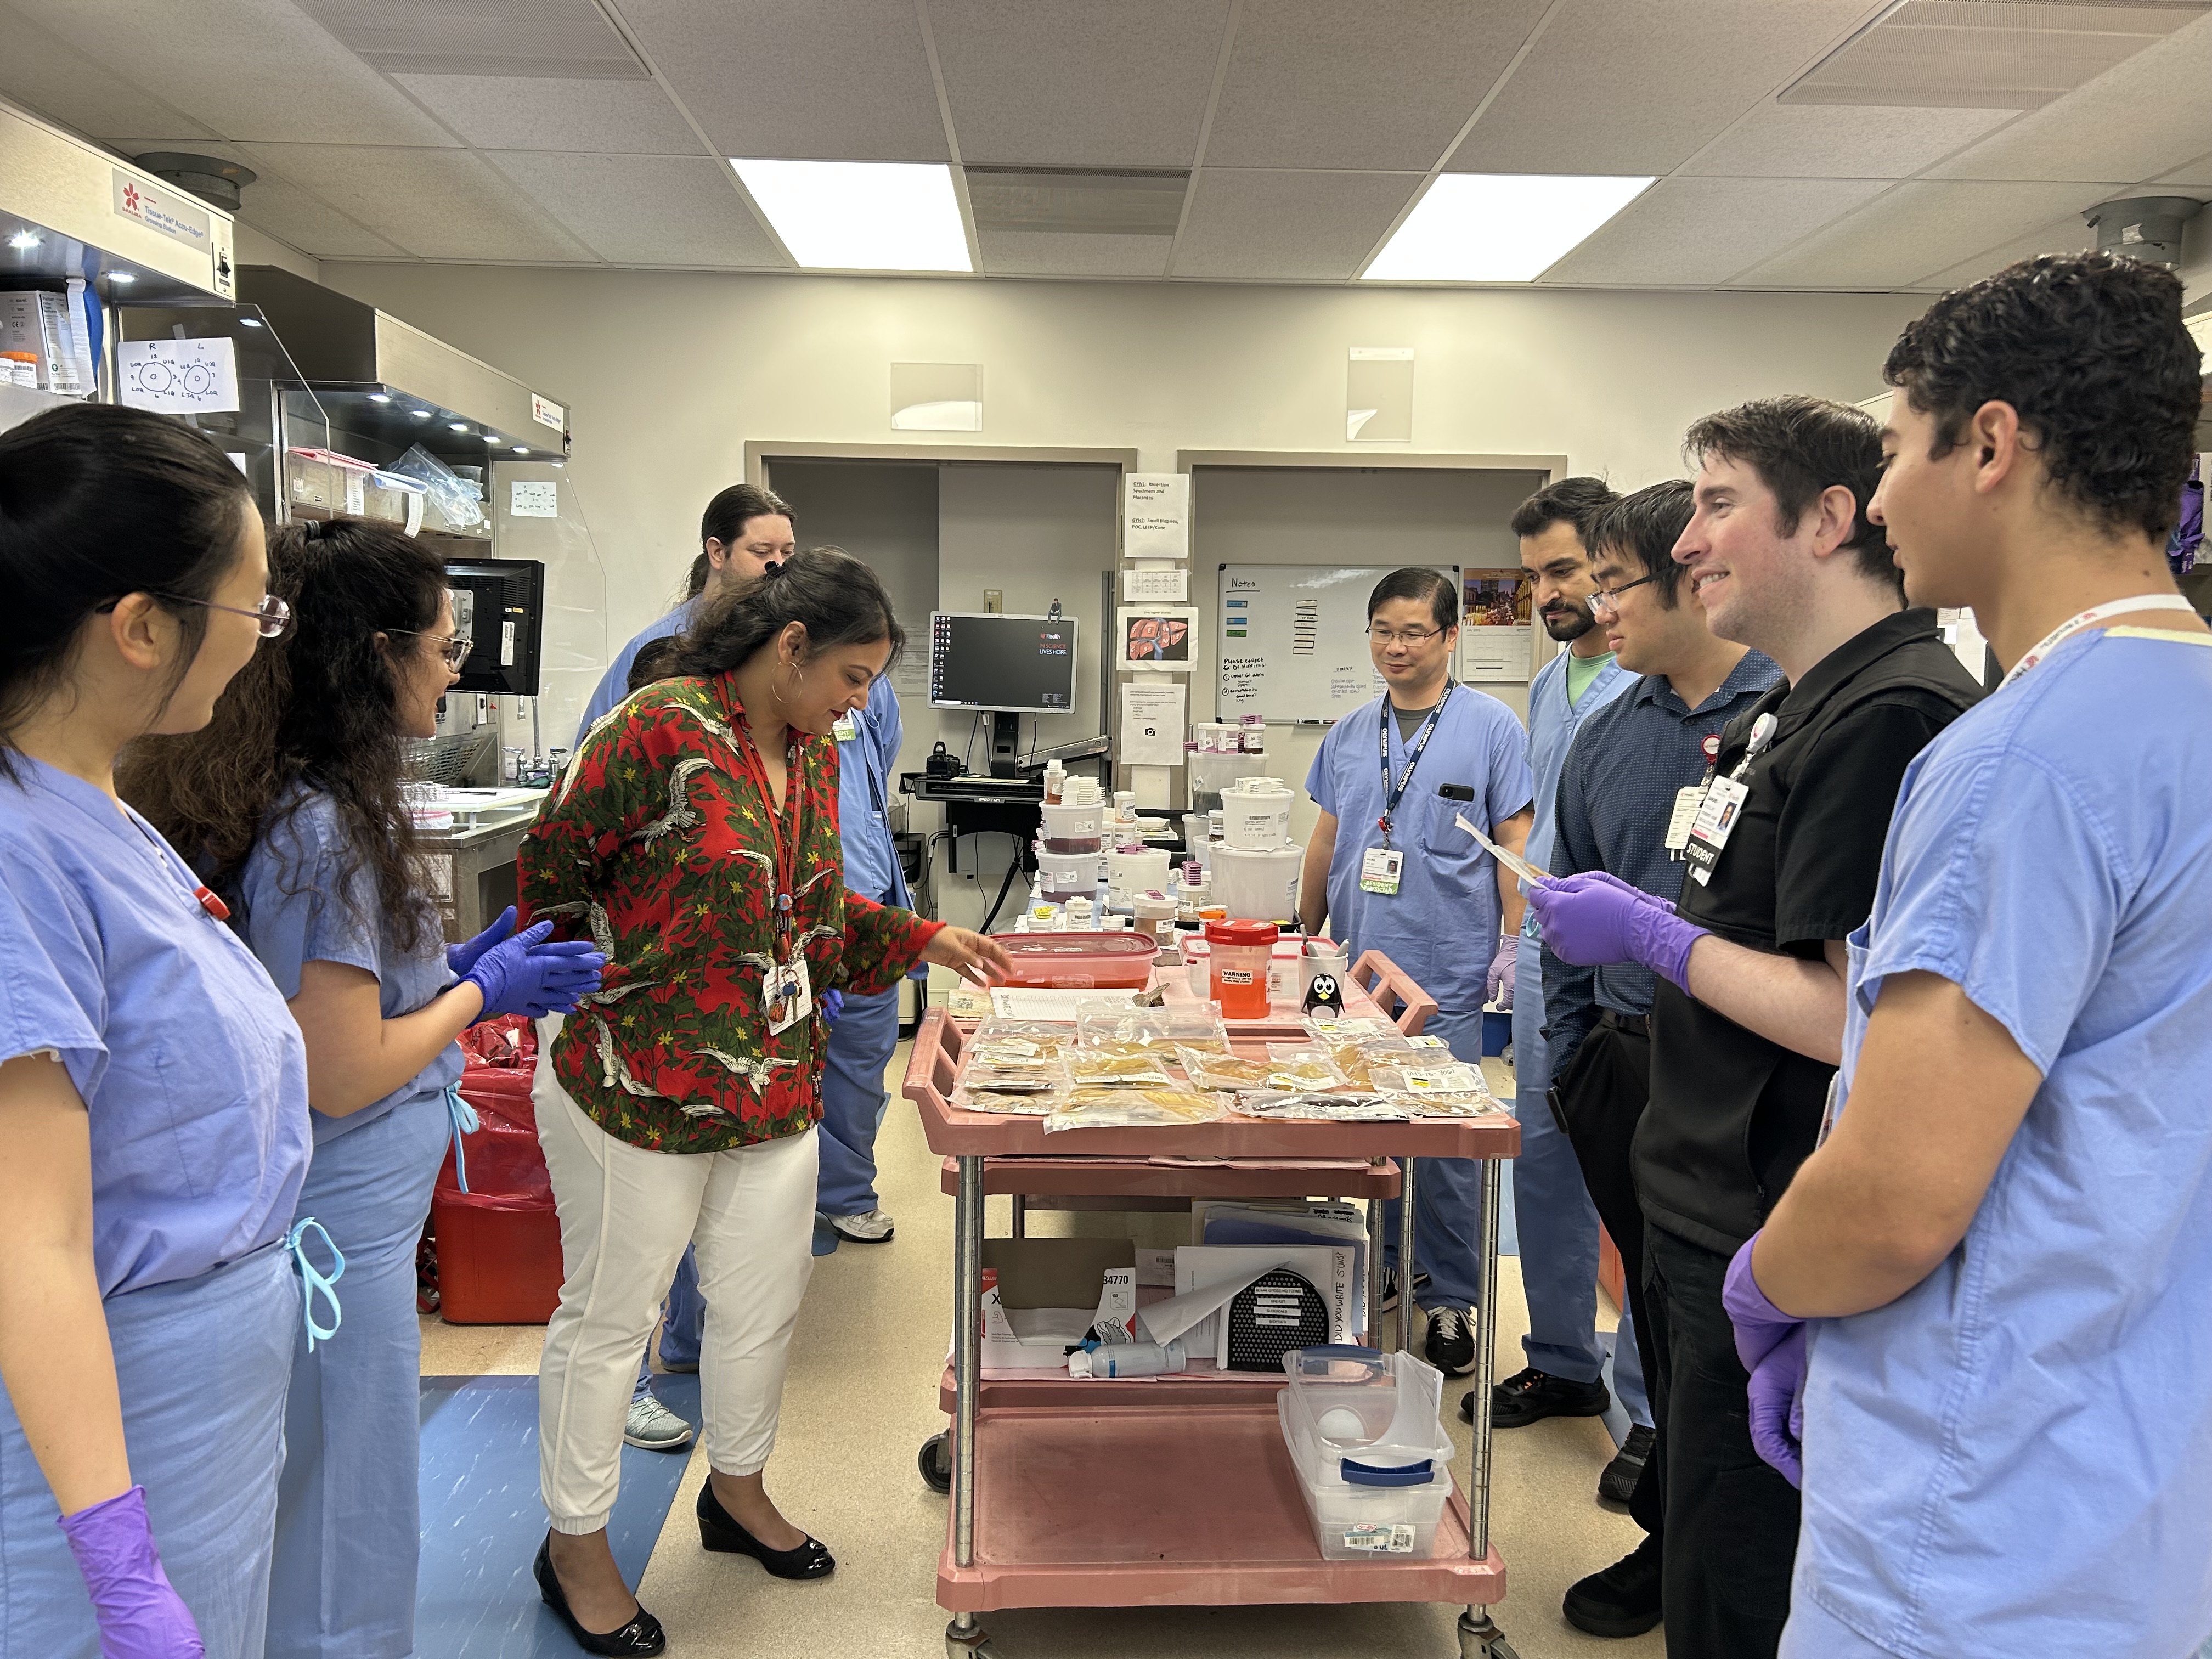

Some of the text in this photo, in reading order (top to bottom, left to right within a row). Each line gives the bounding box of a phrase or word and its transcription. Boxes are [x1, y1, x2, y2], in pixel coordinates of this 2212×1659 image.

[122, 206, 142, 218] SAKURA
[145, 216, 176, 234] Grossing Station
[1232, 577, 1256, 588] Notes
[1435, 687, 1451, 714] OLYMPUS
[1417, 723, 1435, 752] OLYMPUS
[1397, 761, 1415, 793] OLYMPUS
[1686, 842, 1715, 865] STUDENT
[1364, 880, 1393, 888] RESIDENT
[1103, 1275, 1128, 1285] 34770
[1335, 1282, 1344, 1306] WRITE
[1334, 1306, 1344, 1322] YOU
[1335, 1324, 1343, 1341] DID
